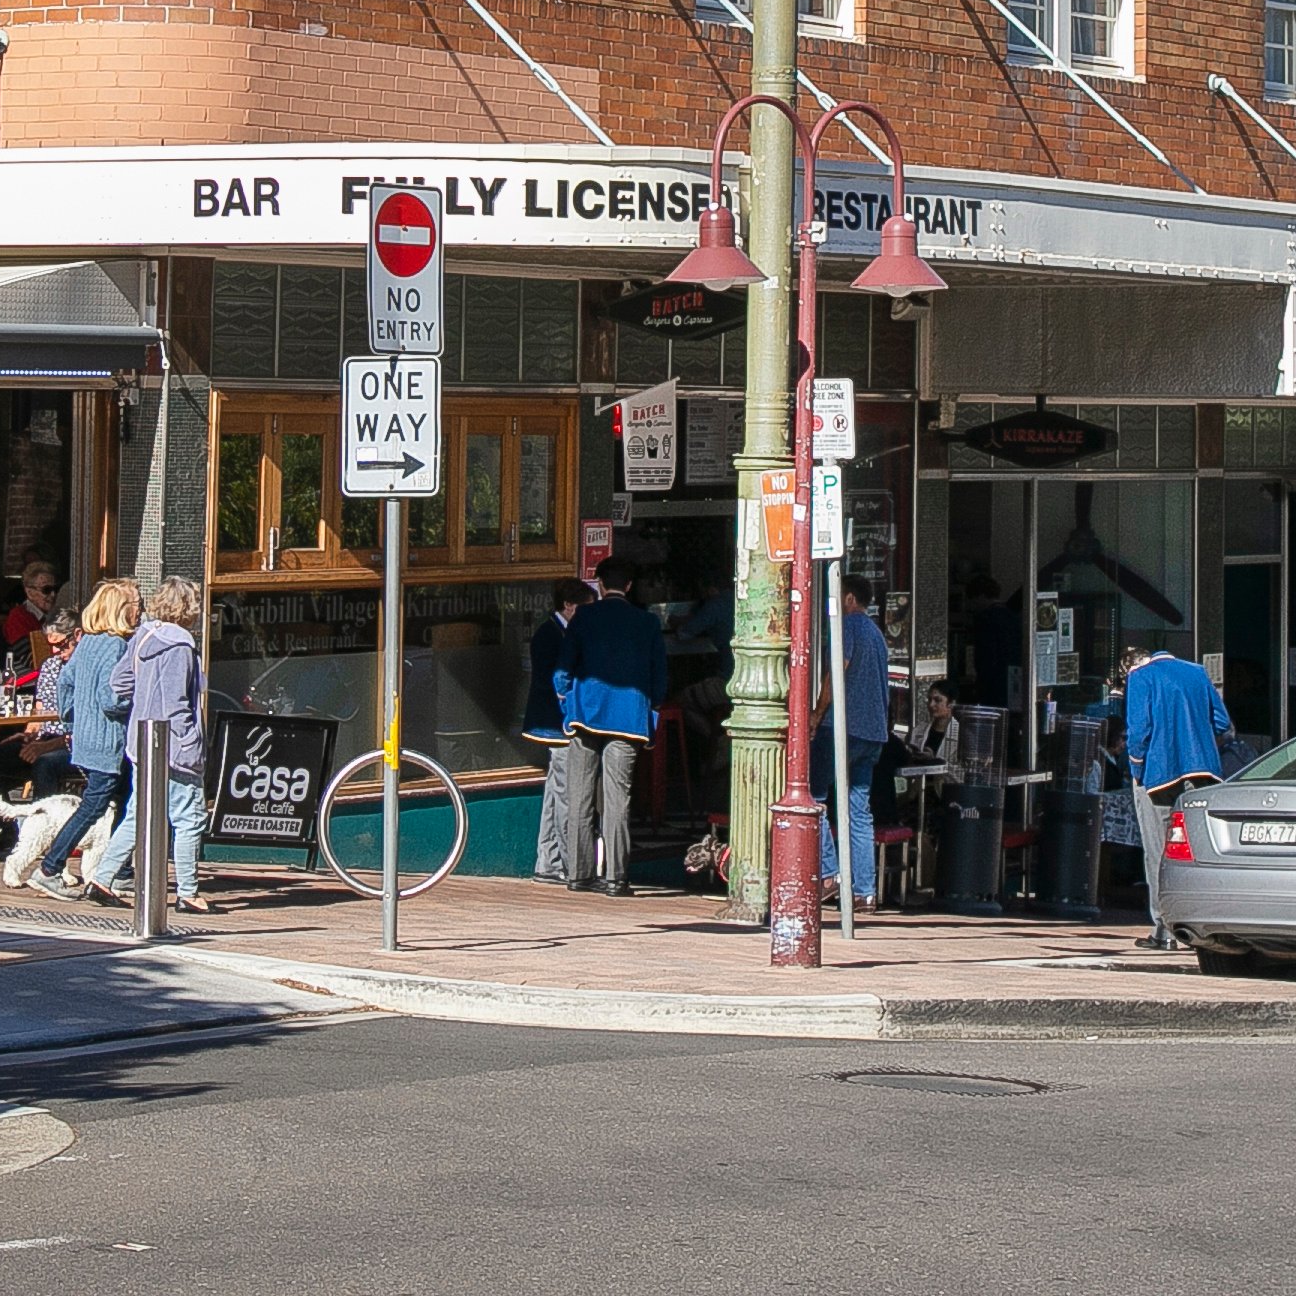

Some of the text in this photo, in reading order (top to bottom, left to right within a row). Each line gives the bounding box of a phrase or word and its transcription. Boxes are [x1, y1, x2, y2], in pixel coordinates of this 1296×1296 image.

[193, 177, 281, 217] BAR
[341, 176, 508, 217] FLY
[813, 189, 983, 237] RESTARANT
[387, 287, 421, 313] NO
[376, 319, 436, 342] ENTRY
[361, 371, 424, 401] ONE
[356, 412, 428, 442] WAY
[1003, 428, 1085, 444] KIRRAKAZE
[770, 475, 788, 491] NO
[762, 491, 795, 506] STOPPIN
[249, 754, 258, 766] La
[230, 764, 310, 802] casa
[252, 800, 268, 814] del
[223, 817, 259, 831] COFFEE
